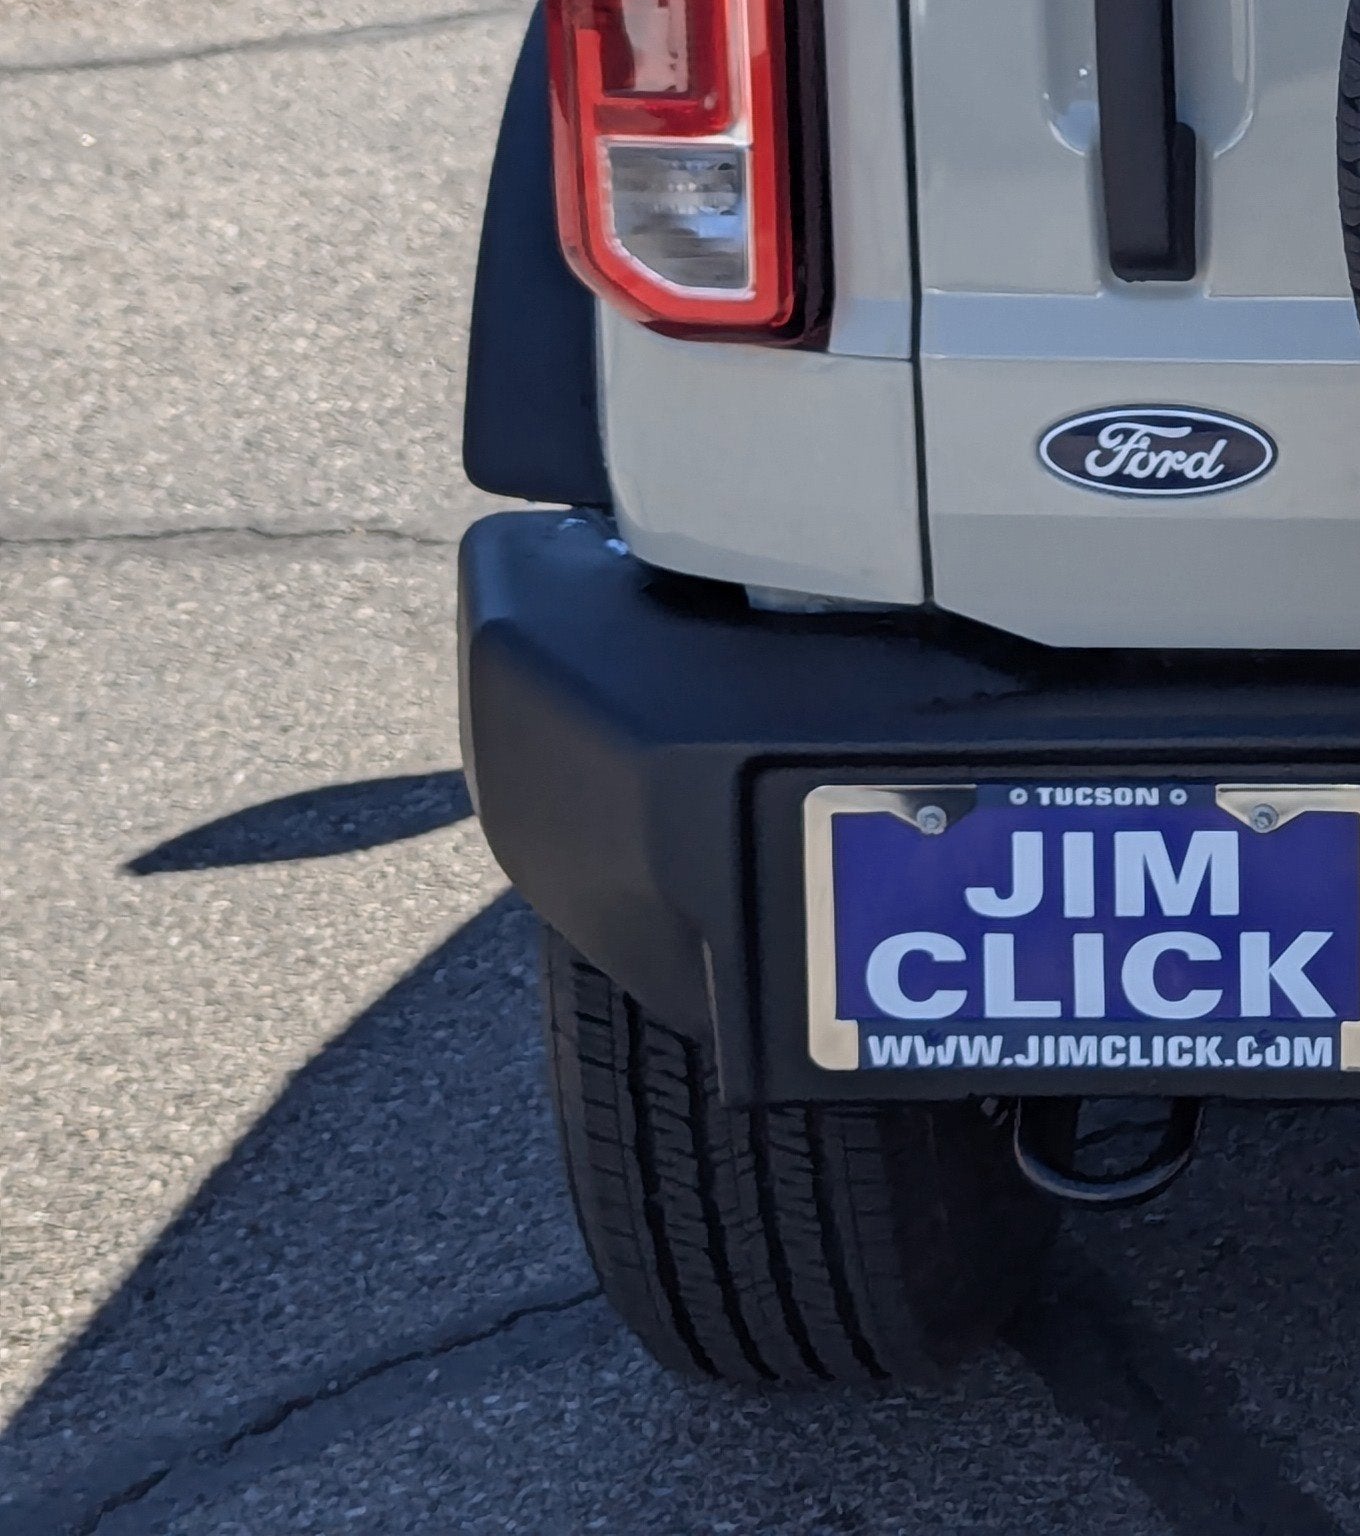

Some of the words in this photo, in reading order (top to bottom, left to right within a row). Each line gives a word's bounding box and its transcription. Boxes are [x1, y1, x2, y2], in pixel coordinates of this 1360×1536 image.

[1084, 421, 1228, 480] Ford
[1037, 786, 1161, 807] TUCSON
[964, 829, 1240, 918] JIM
[864, 930, 1337, 1020] CLICK
[868, 1034, 1334, 1068] WWW.JIMCLICK.COM
